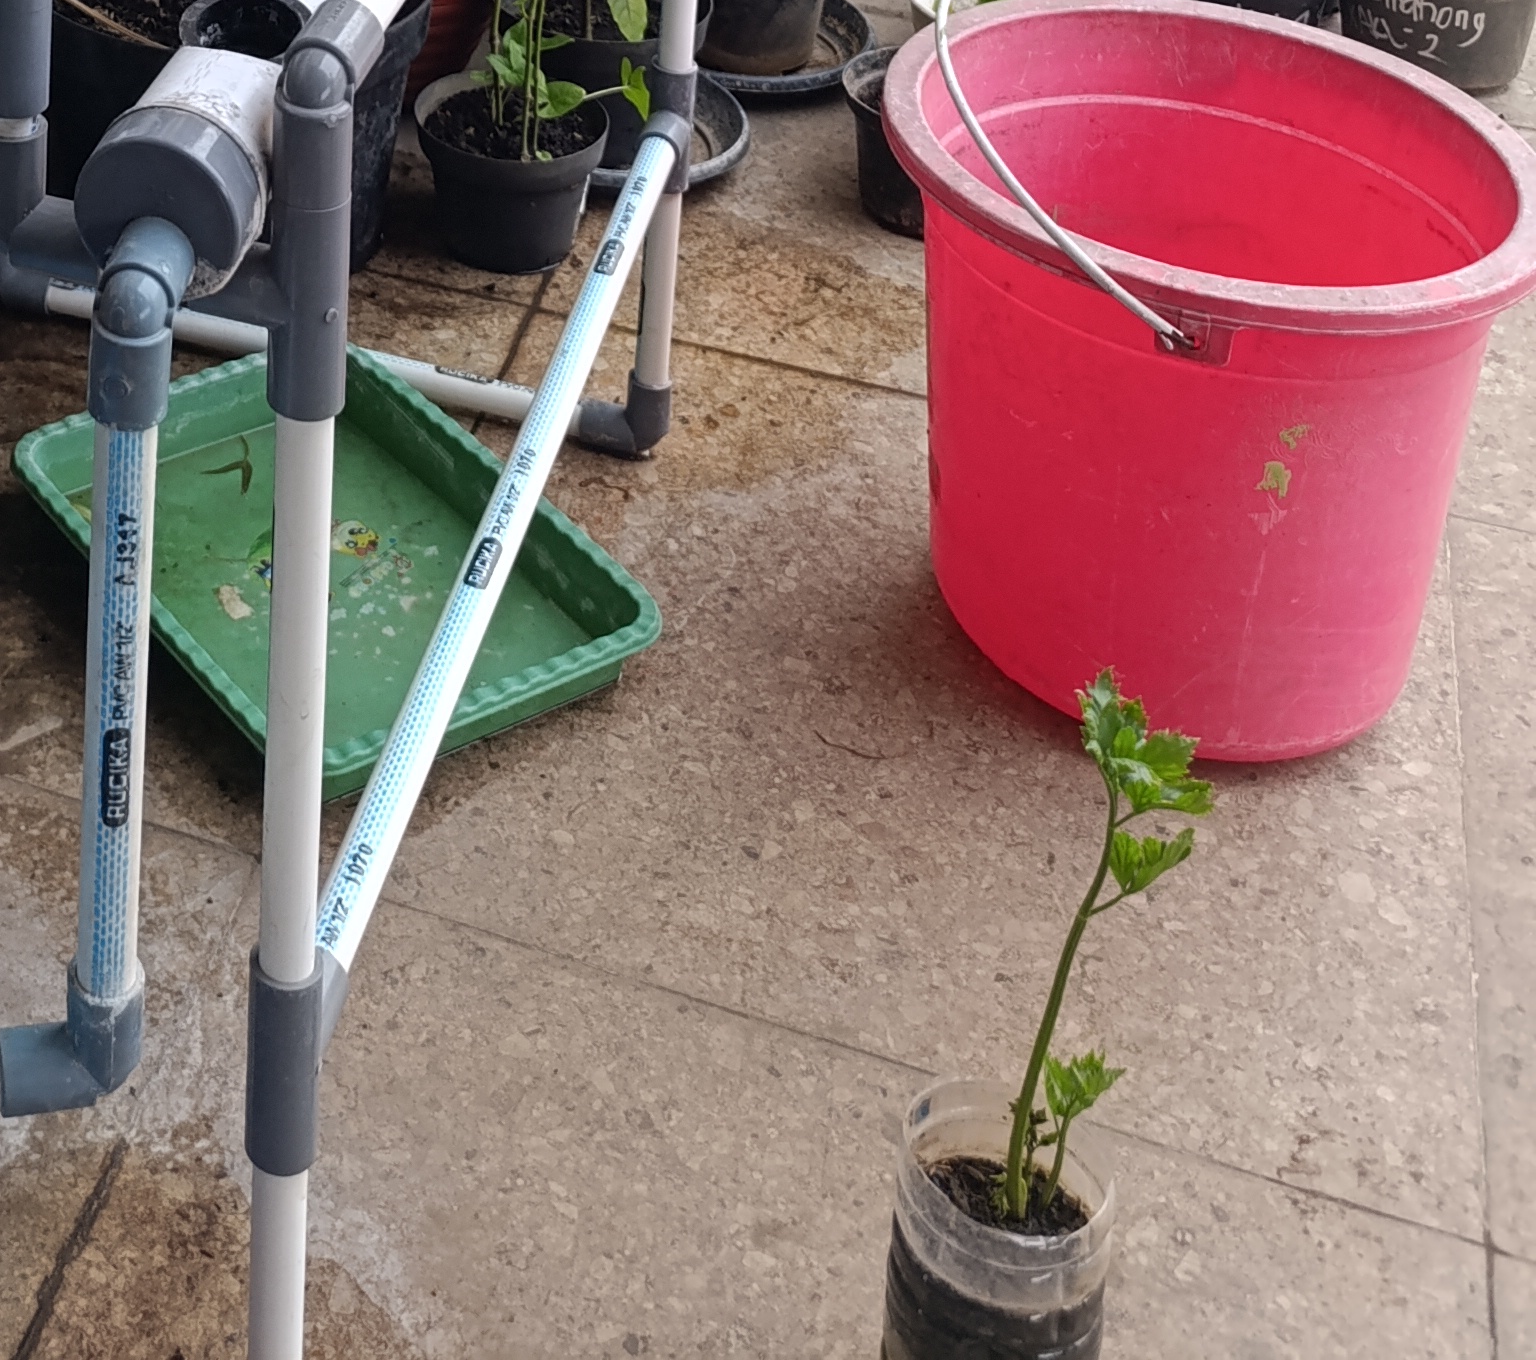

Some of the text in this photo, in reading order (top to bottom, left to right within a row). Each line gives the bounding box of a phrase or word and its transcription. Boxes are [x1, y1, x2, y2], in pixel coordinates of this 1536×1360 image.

[467, 541, 498, 586] RUCIKA
[106, 736, 129, 818] RUCIKA
[342, 843, 373, 886] 1070
